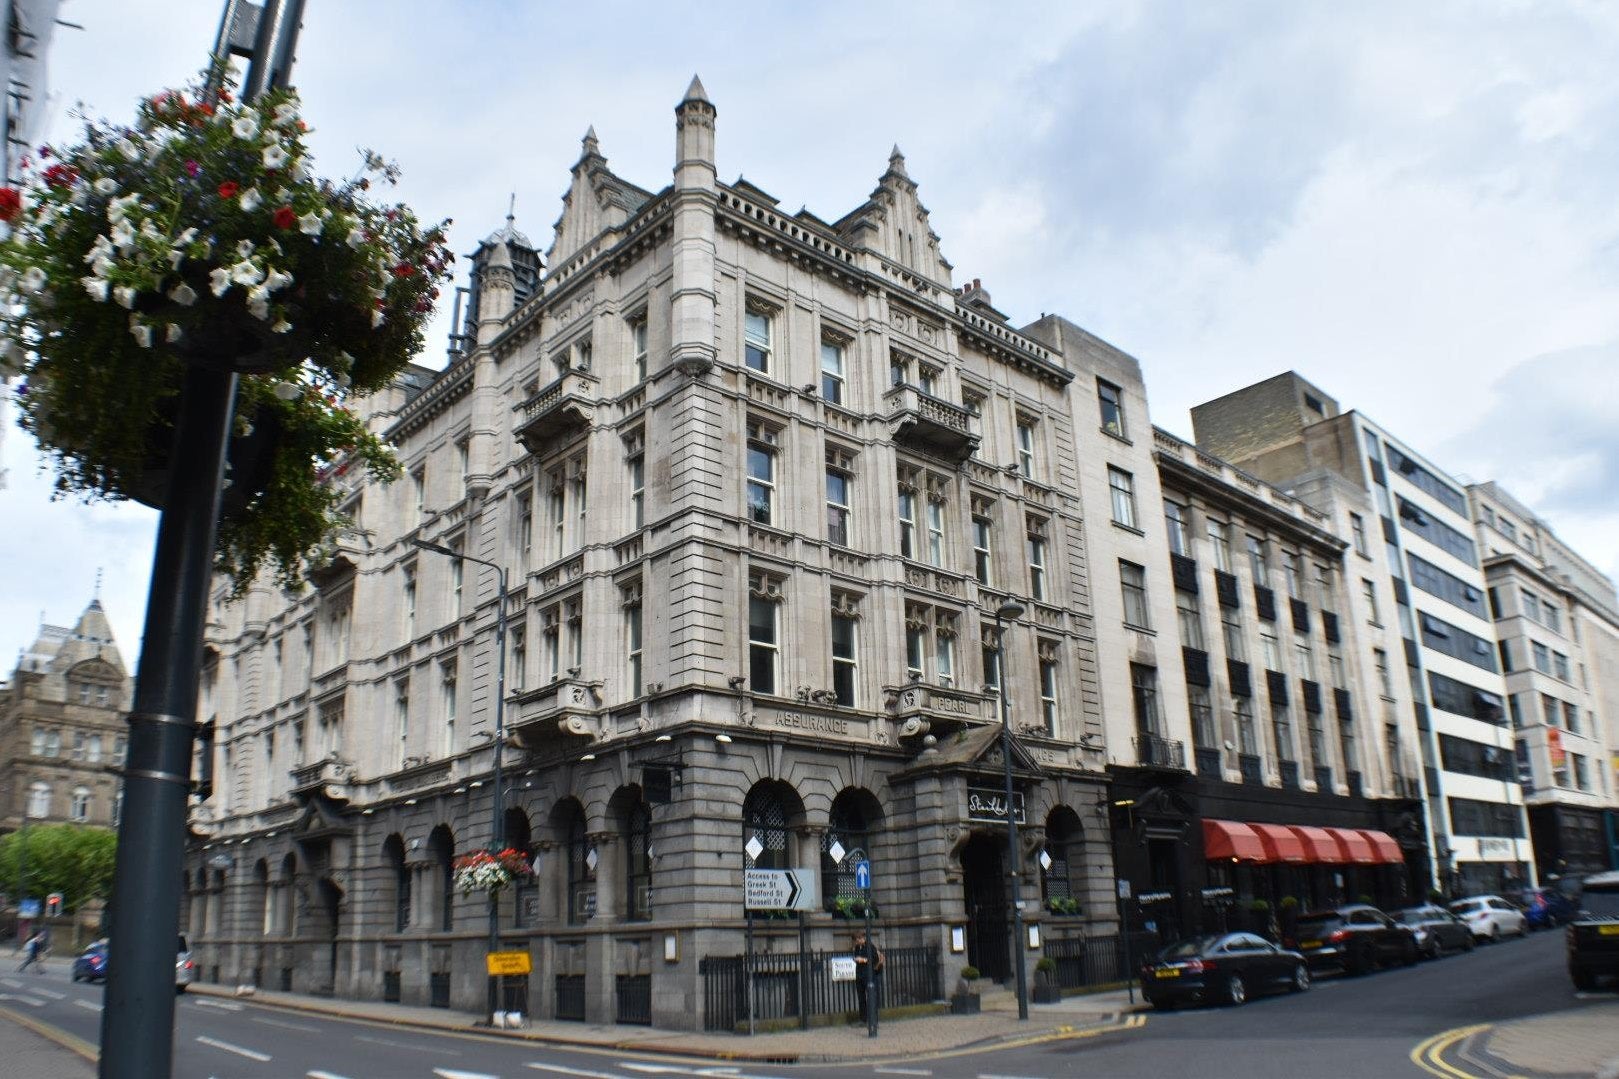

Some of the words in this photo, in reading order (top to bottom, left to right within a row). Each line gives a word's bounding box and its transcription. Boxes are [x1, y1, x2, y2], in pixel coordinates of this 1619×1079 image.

[776, 711, 848, 735] ASSURANCE
[747, 872, 770, 880] Access
[771, 872, 779, 880] to
